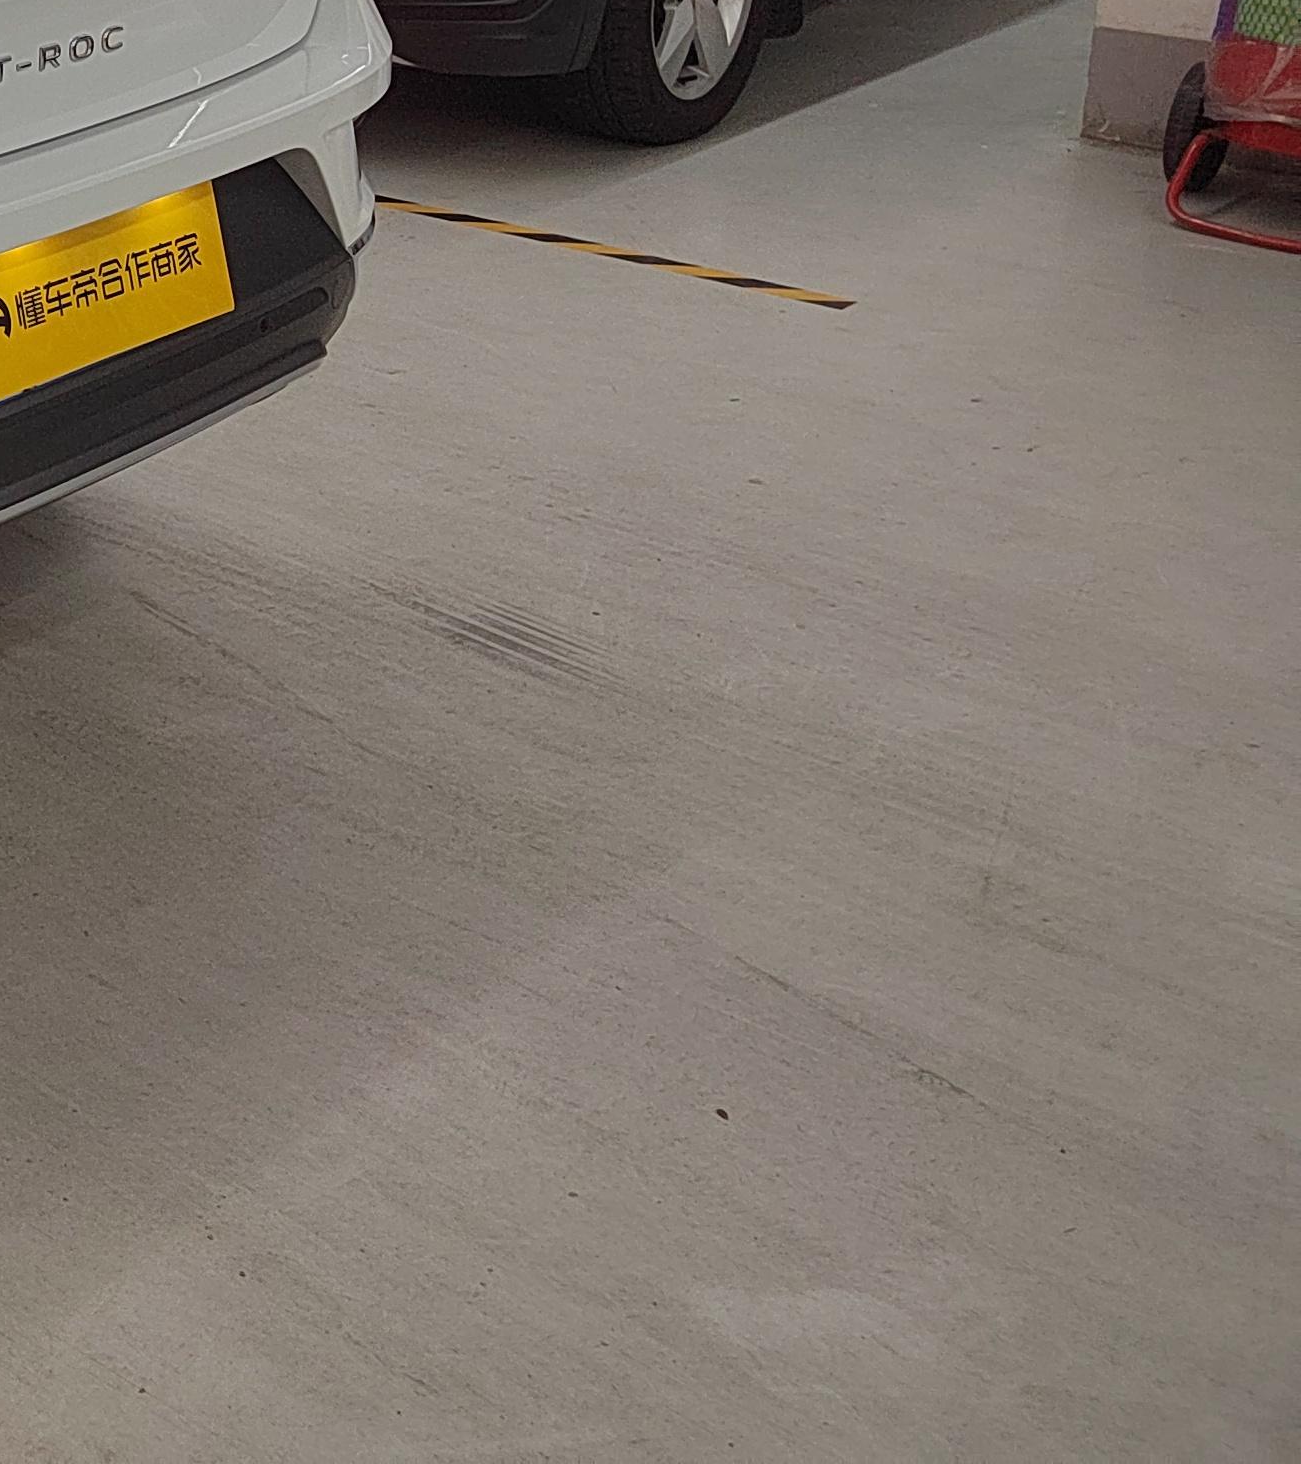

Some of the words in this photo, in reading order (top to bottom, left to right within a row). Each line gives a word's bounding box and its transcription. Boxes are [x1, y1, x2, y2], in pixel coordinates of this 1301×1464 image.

[14, 232, 202, 330] 懂车帝合作商家
